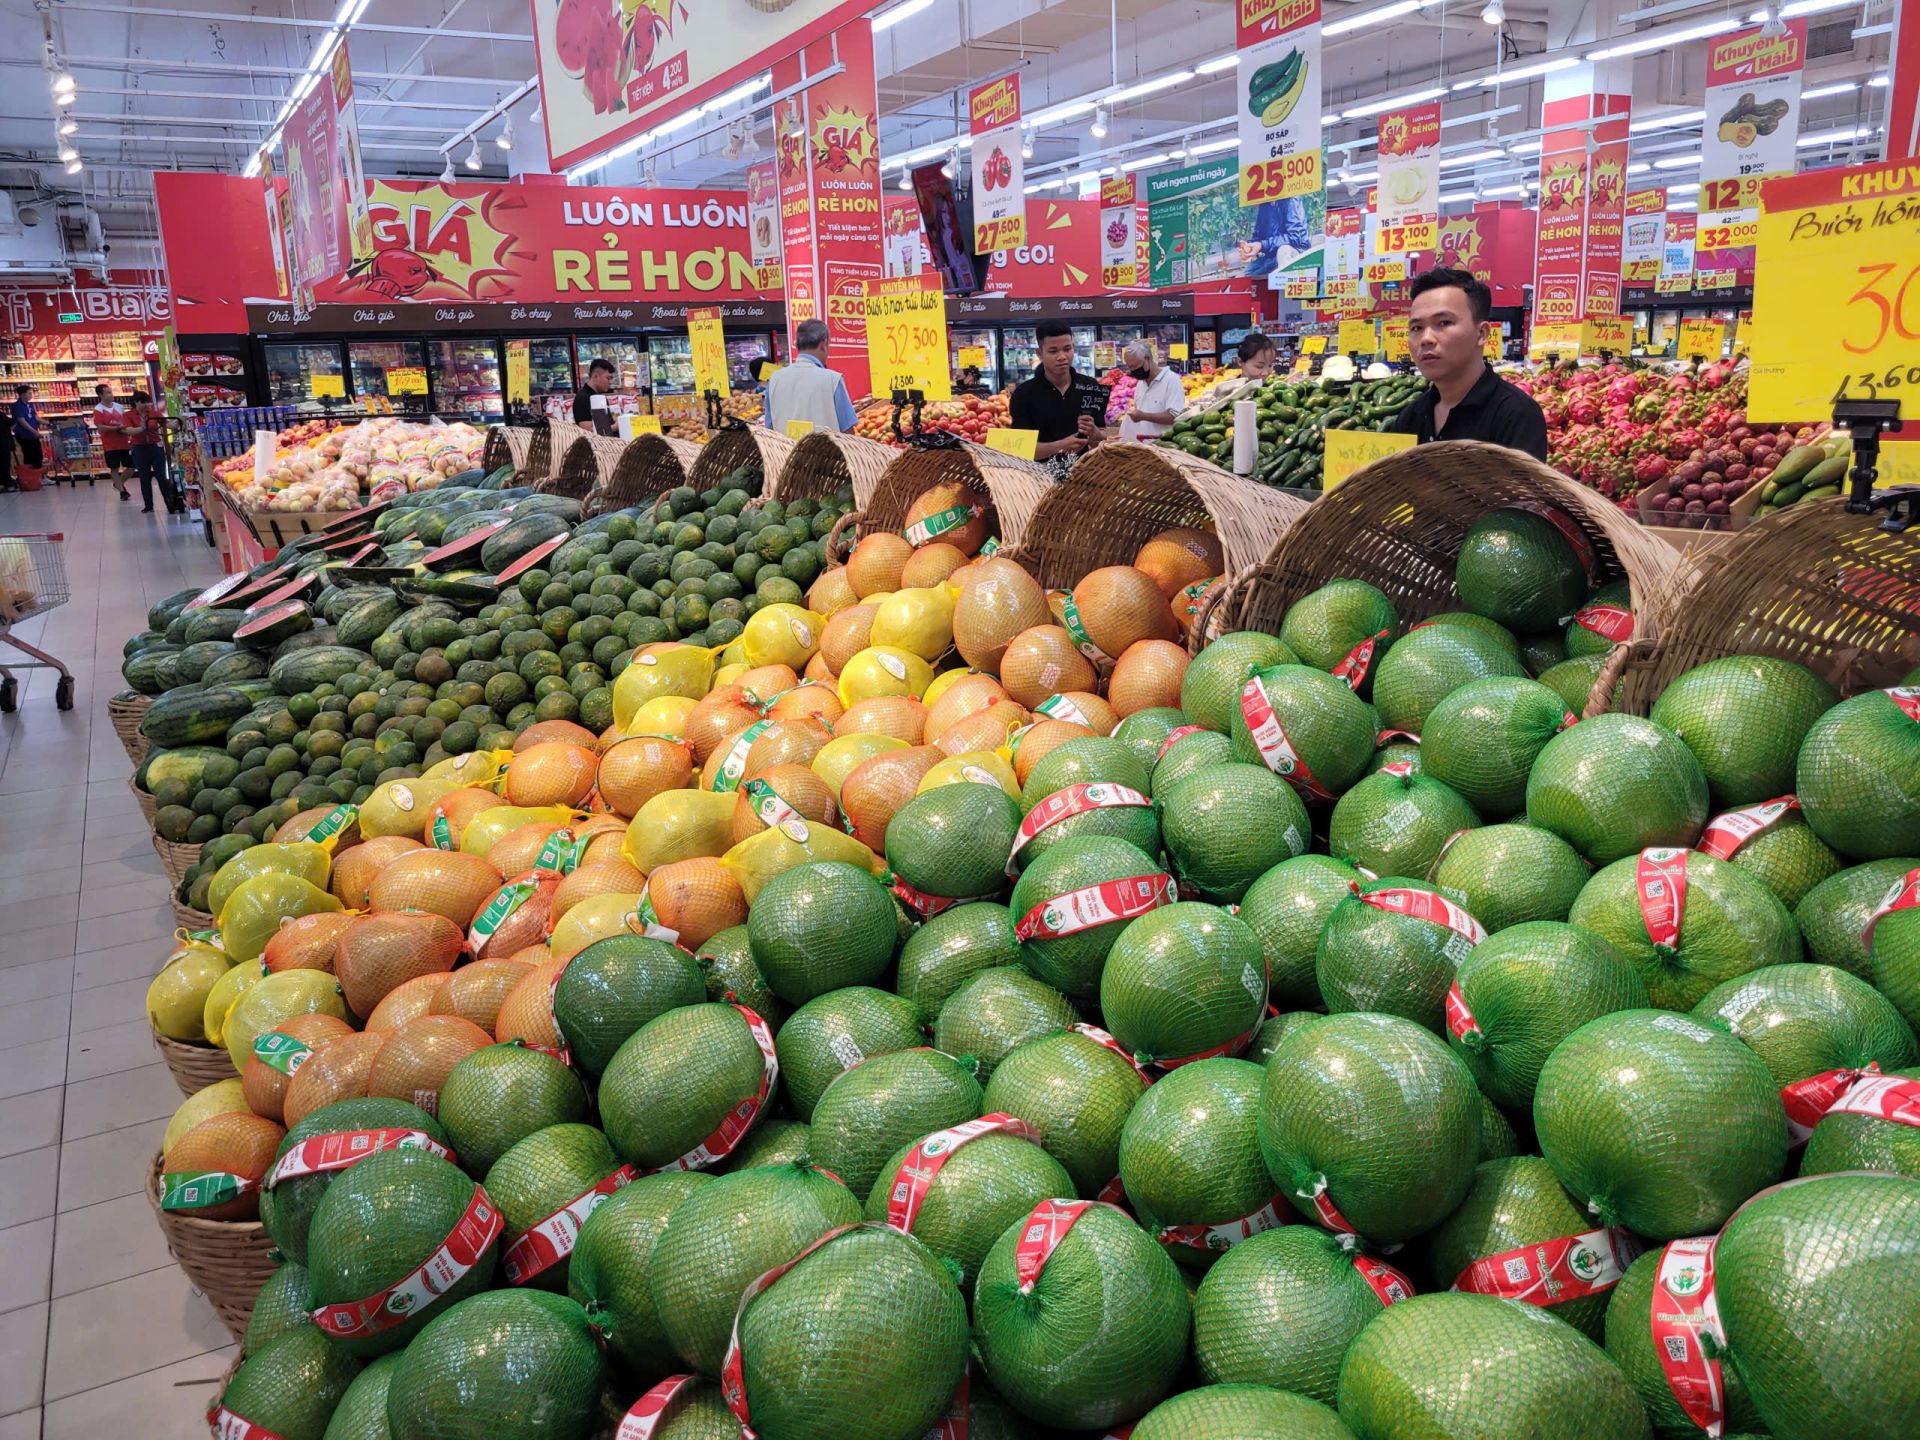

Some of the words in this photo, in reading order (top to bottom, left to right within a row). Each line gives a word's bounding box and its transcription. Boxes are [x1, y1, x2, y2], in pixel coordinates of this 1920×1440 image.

[1759, 40, 1796, 71] Mãi!
[974, 85, 1004, 114] Khuyến
[996, 93, 1014, 121] Mãi!
[823, 125, 864, 155] GIÁ
[1276, 129, 1289, 138] SÁP
[822, 180, 846, 190] LUÔN
[848, 180, 873, 190] LUÔN
[1152, 181, 1168, 190] Tươi
[1169, 176, 1189, 188] ngon
[1190, 169, 1206, 182] mỗi
[1206, 168, 1227, 180] ngày
[1246, 156, 1314, 202] 25.900
[1549, 174, 1576, 196] GIÁ
[1597, 174, 1618, 194] GIÁ
[818, 192, 840, 212] RẺ
[842, 197, 878, 212] HƠN
[1705, 178, 1772, 211] 12.9
[564, 196, 654, 226] LUÔN
[663, 198, 748, 228] LUÔN
[353, 199, 477, 267] GIÁ
[978, 218, 1020, 252] 27.600
[1382, 226, 1429, 252] 13.100
[1540, 225, 1554, 240] RẺ
[1556, 226, 1581, 238] HƠN
[1589, 222, 1600, 236] RẺ
[1602, 225, 1620, 236] HƠN
[1704, 224, 1758, 248] 32.000
[1441, 229, 1474, 254] GIÁ
[552, 232, 632, 292] RẺ
[641, 246, 757, 292] HƠN
[1014, 244, 1055, 265] GO!
[88, 293, 143, 316] Bia
[574, 307, 593, 318] Rau
[595, 306, 612, 318] hỗn
[614, 308, 633, 324] hợp
[652, 306, 678, 318] Khoai
[792, 302, 814, 318] 2.000
[830, 299, 866, 316] 2.00
[1540, 302, 1573, 312] 2.000
[1588, 299, 1614, 312] 2.000
[267, 310, 290, 322] Chả
[353, 310, 376, 322] Chả
[378, 310, 396, 326] giò
[434, 309, 456, 321] Chả
[458, 310, 475, 324] giò
[510, 308, 526, 320] Đồ
[528, 309, 552, 324] chay
